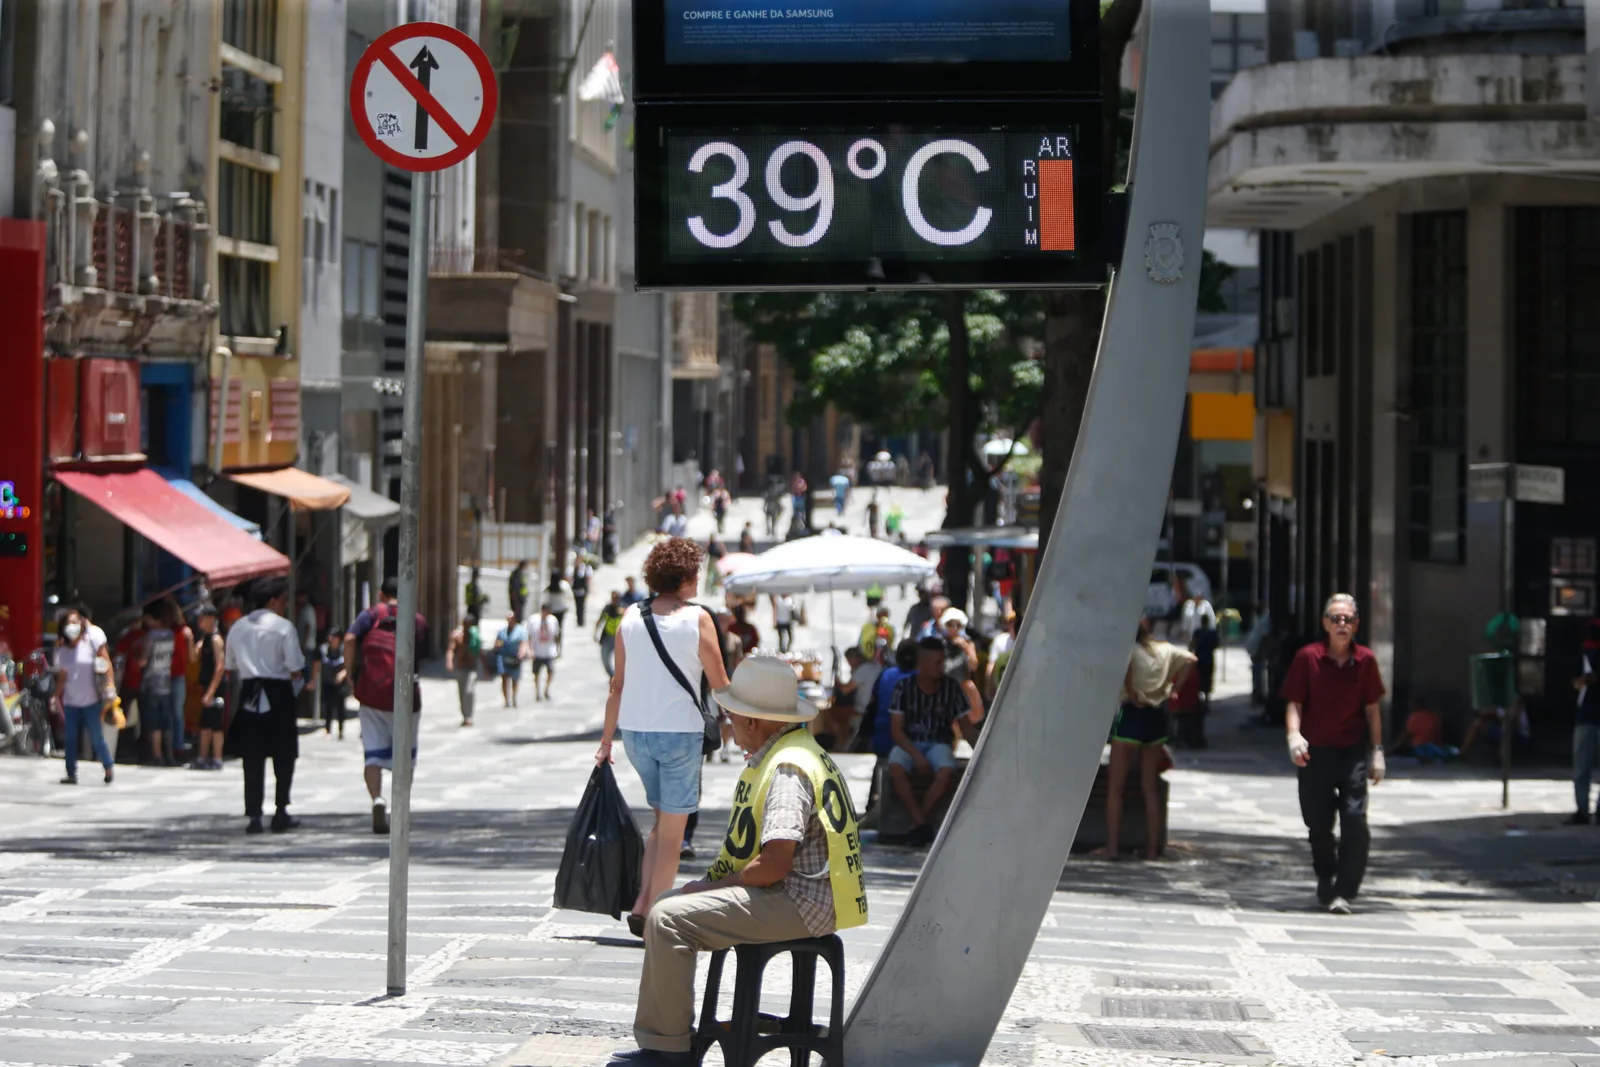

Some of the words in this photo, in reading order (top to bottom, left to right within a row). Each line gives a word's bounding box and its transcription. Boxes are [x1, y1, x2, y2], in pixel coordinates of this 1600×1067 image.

[683, 10, 724, 20] COMPRE
[725, 10, 732, 20] E
[733, 10, 768, 19] GANHE
[769, 9, 784, 19] DA
[786, 9, 834, 19] SAMSUNG
[1038, 136, 1071, 157] AR
